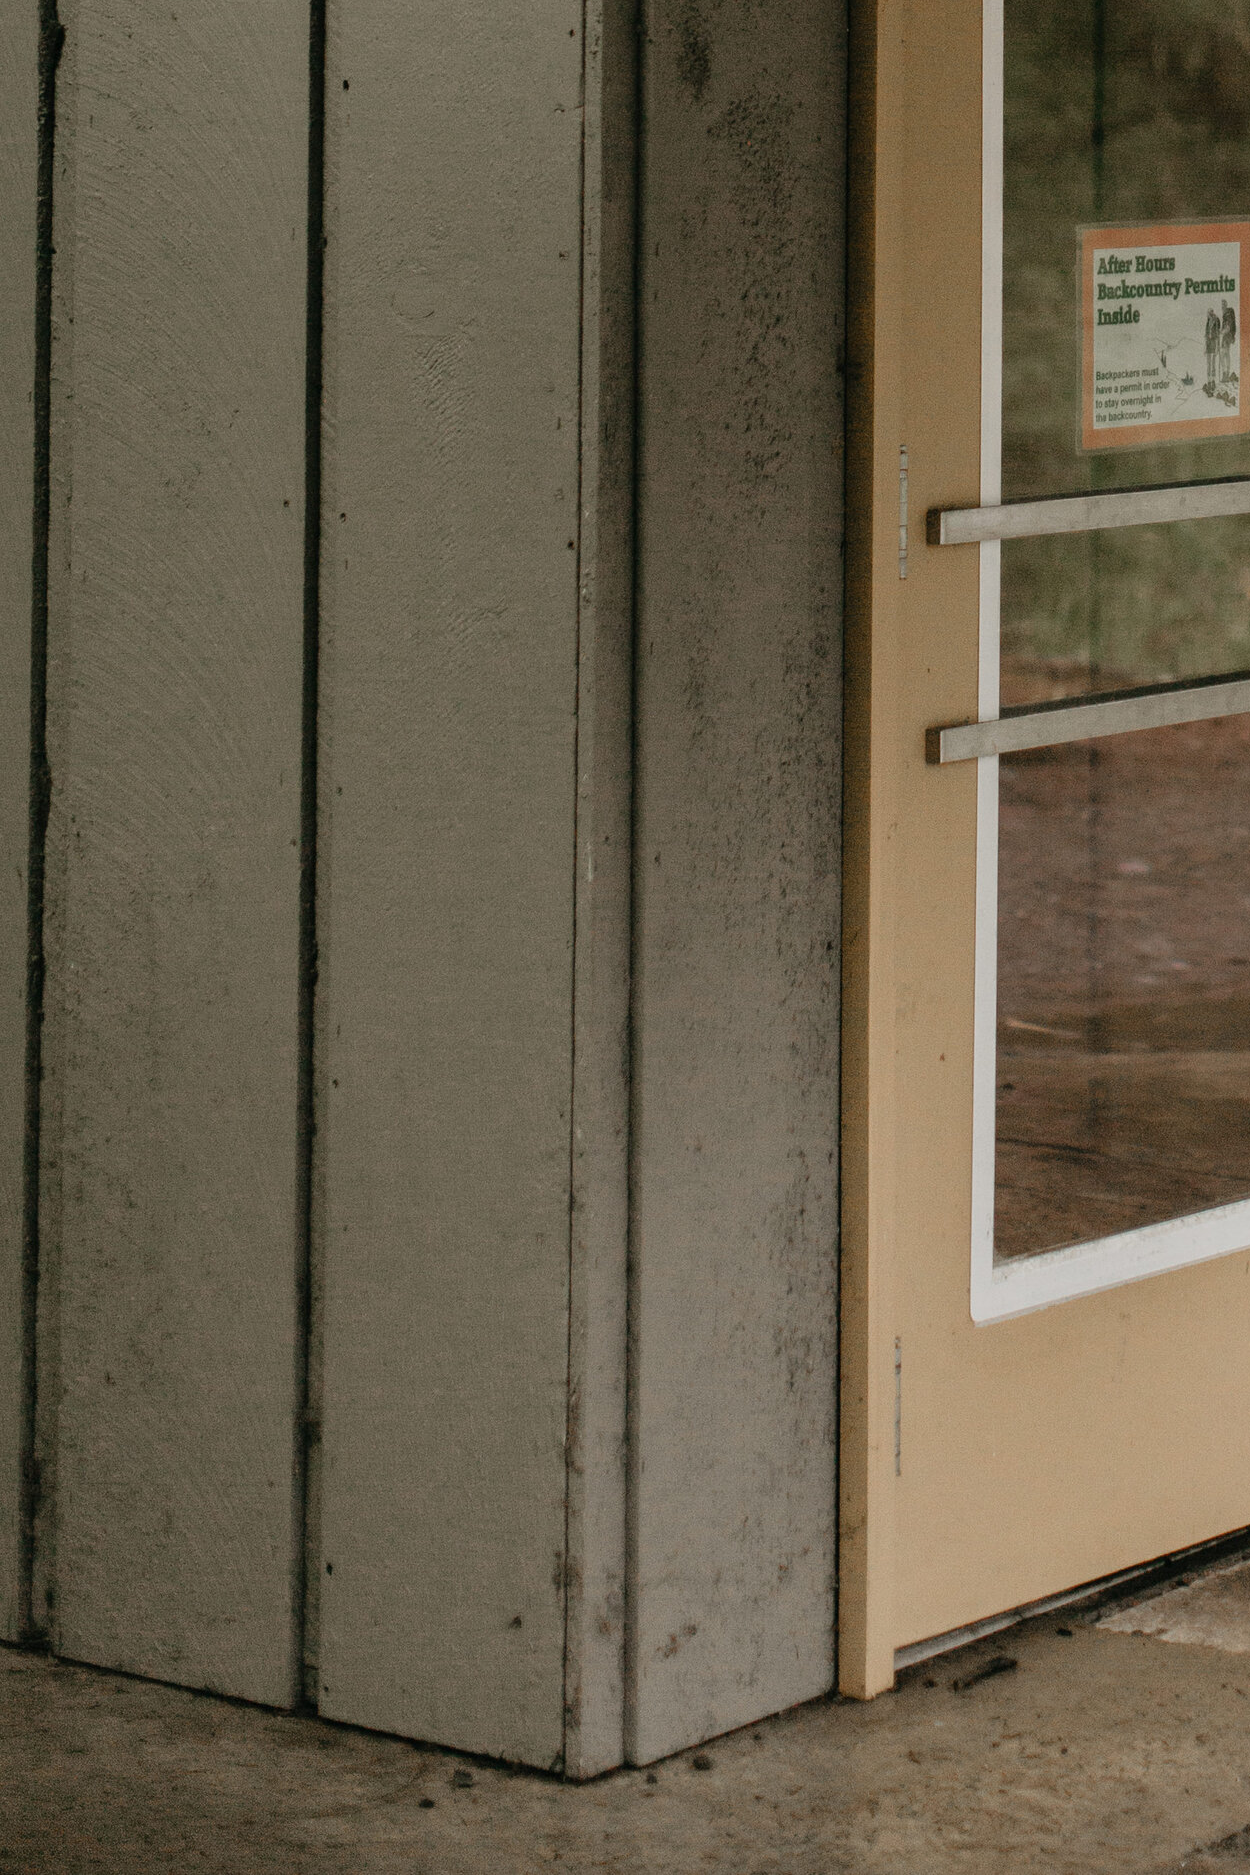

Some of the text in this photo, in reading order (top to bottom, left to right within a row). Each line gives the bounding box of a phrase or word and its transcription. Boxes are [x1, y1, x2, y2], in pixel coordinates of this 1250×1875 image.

[1097, 254, 1176, 275] After Hours
[1097, 274, 1236, 300] Backcountry Permits
[1097, 304, 1141, 326] Inside
[1095, 367, 1159, 381] Backpackers must
[1095, 386, 1112, 395] have
[1120, 382, 1143, 395] permit
[1152, 380, 1170, 390] order
[1095, 400, 1103, 409] to
[1104, 398, 1119, 409] stay
[1120, 394, 1153, 406] overnight
[1095, 410, 1152, 423] the backcountry.
